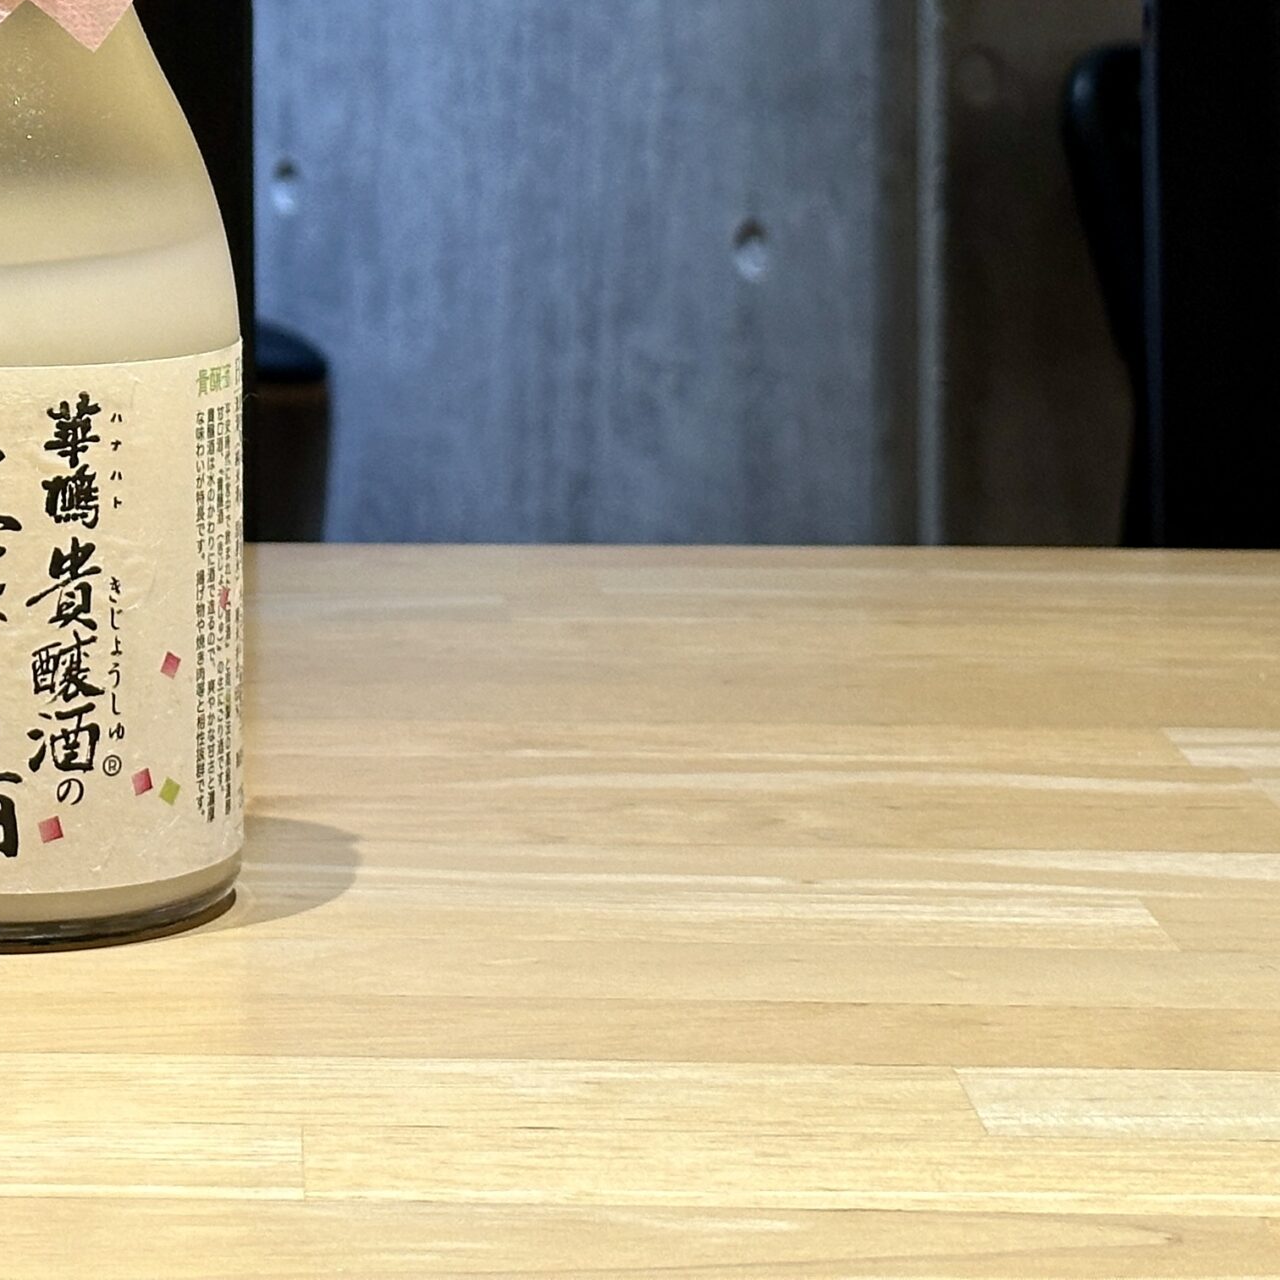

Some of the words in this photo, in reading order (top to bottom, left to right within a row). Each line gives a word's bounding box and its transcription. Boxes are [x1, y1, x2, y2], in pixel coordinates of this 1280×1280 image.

[111, 413, 123, 509] ハナハト
[108, 576, 125, 741] きじょうしゅ
